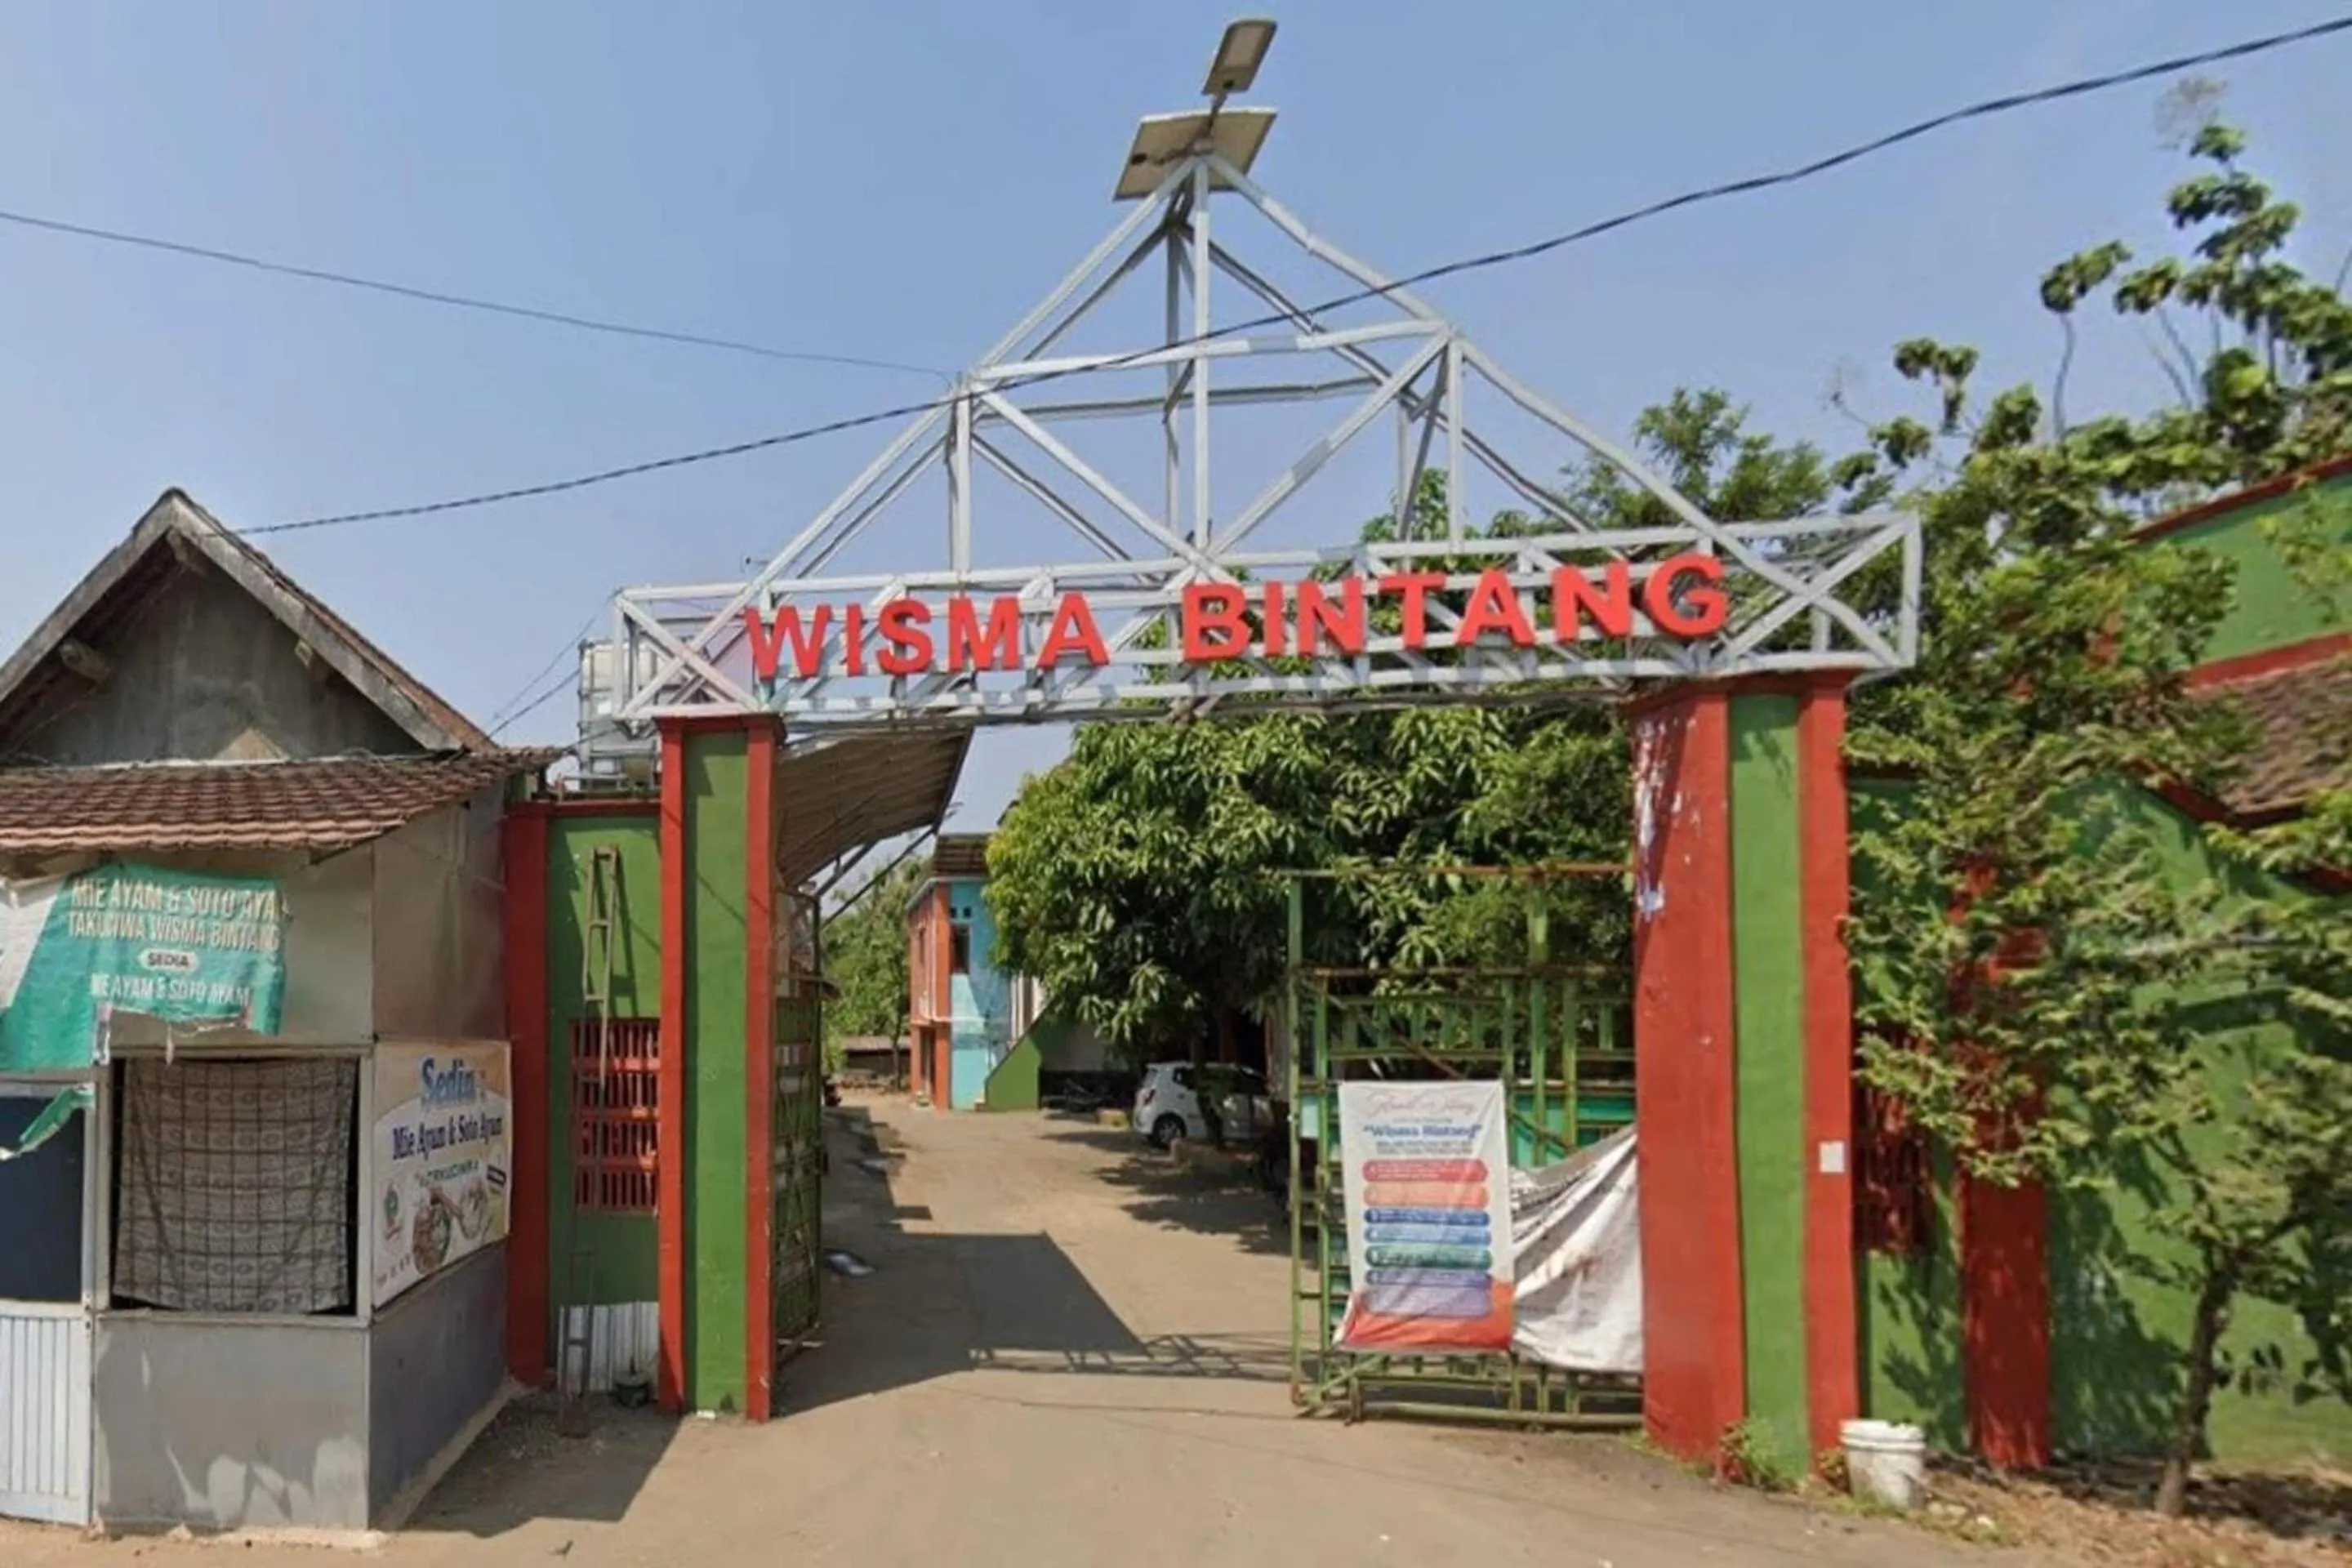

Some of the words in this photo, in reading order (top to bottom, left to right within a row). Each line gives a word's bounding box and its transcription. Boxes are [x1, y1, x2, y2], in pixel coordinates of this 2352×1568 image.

[746, 591, 1109, 679] WISMA
[1181, 553, 1729, 663] BINTANG
[109, 878, 163, 911] AYAM
[189, 885, 237, 920] SOTO
[149, 912, 205, 946] WISMA
[147, 951, 189, 967] SEDIA
[111, 976, 154, 1000] AYAM
